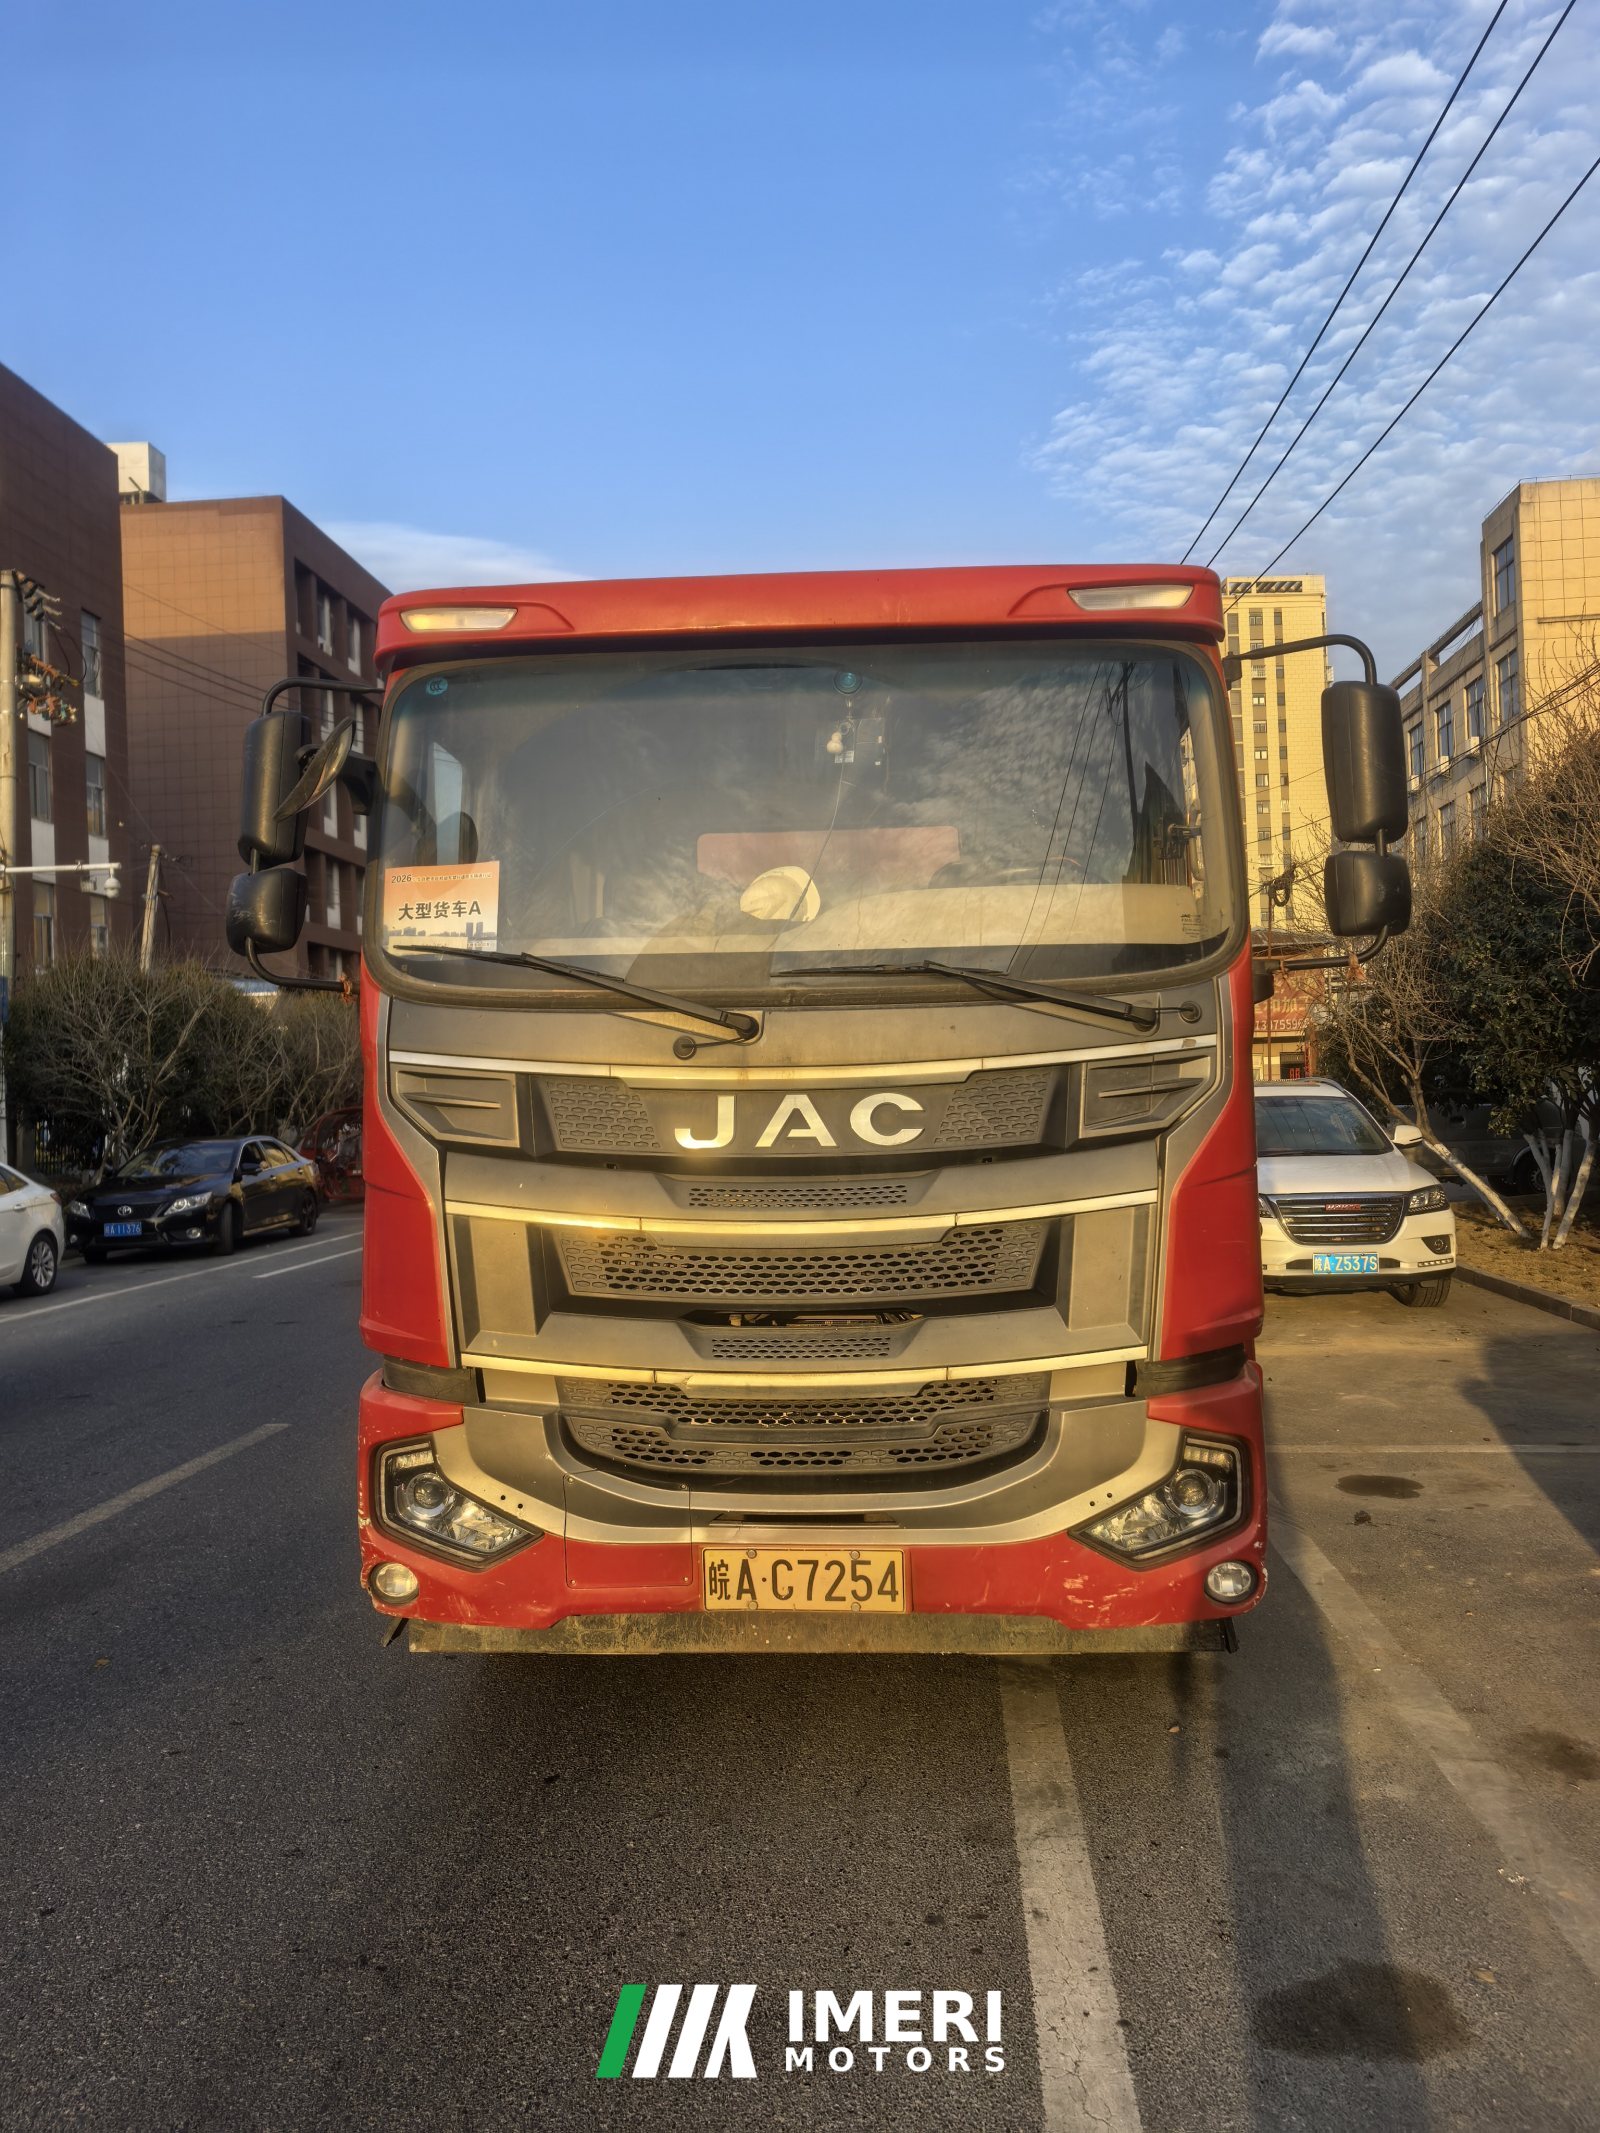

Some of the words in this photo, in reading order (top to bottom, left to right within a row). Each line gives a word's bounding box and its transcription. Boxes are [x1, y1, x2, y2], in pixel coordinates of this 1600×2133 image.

[391, 874, 412, 884] 2026
[398, 900, 481, 920] 大型货车A
[674, 1092, 925, 1149] JAC
[708, 1558, 899, 1602] 皖A·C7254
